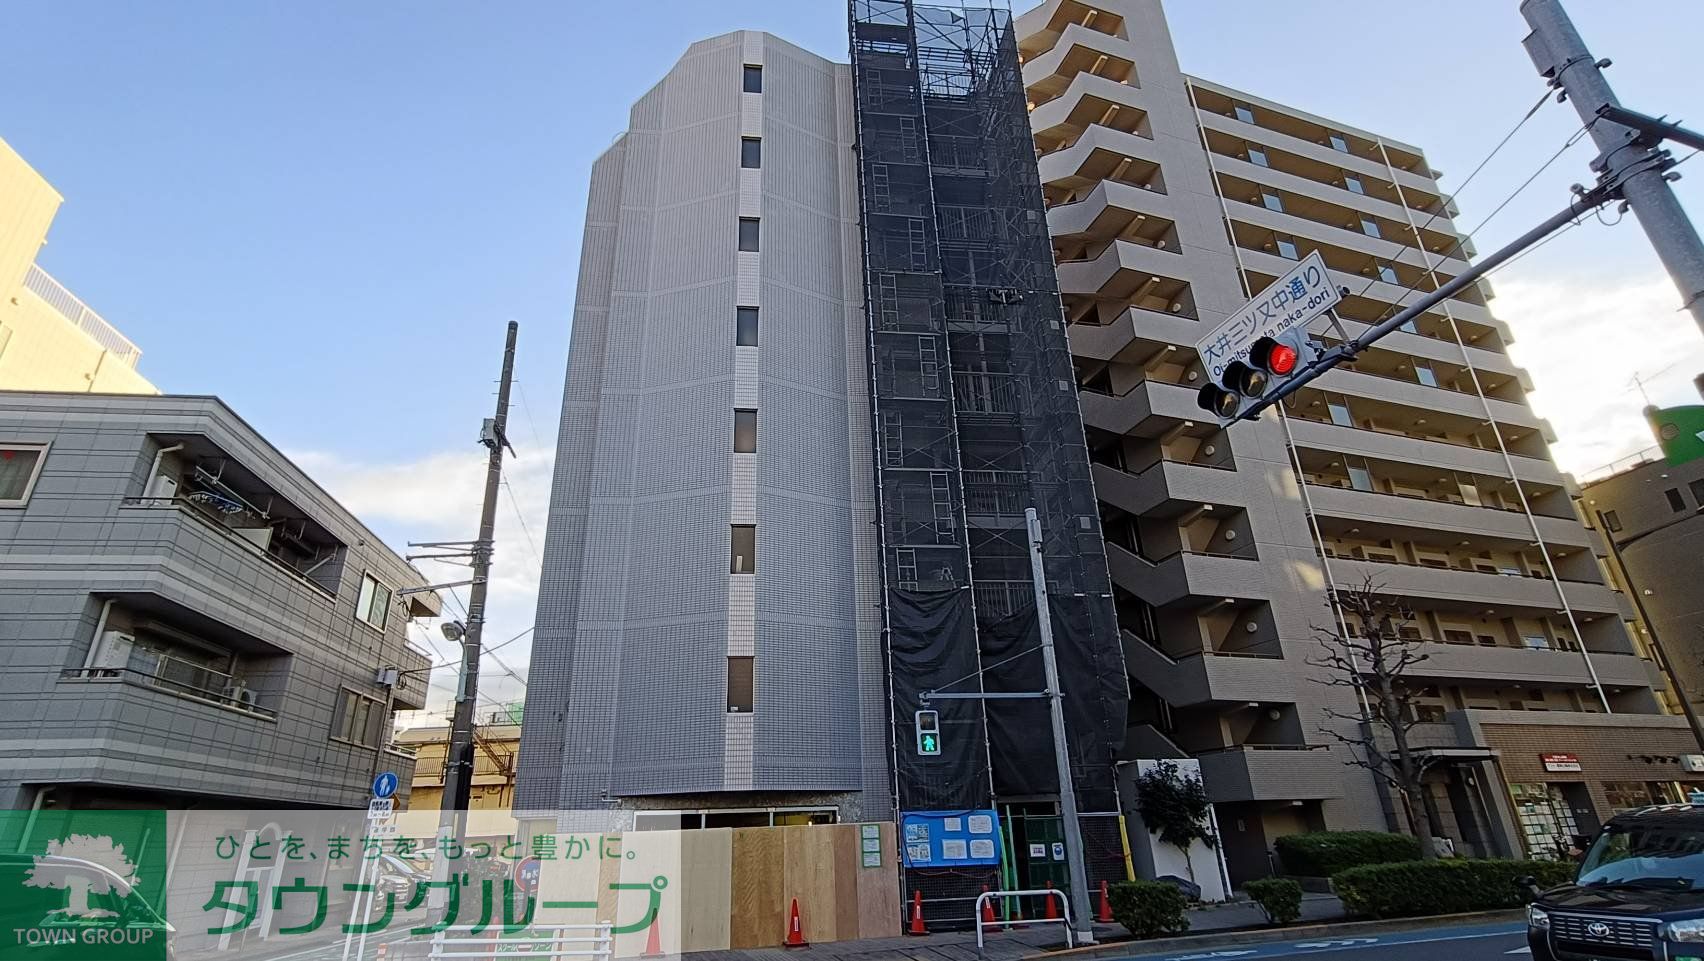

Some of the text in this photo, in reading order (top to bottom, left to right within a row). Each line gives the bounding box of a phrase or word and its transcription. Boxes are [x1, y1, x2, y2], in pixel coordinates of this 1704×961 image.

[1203, 265, 1321, 365] 大井三ツ又中通り
[1213, 289, 1330, 376] Oi-mitsuta naka-dori
